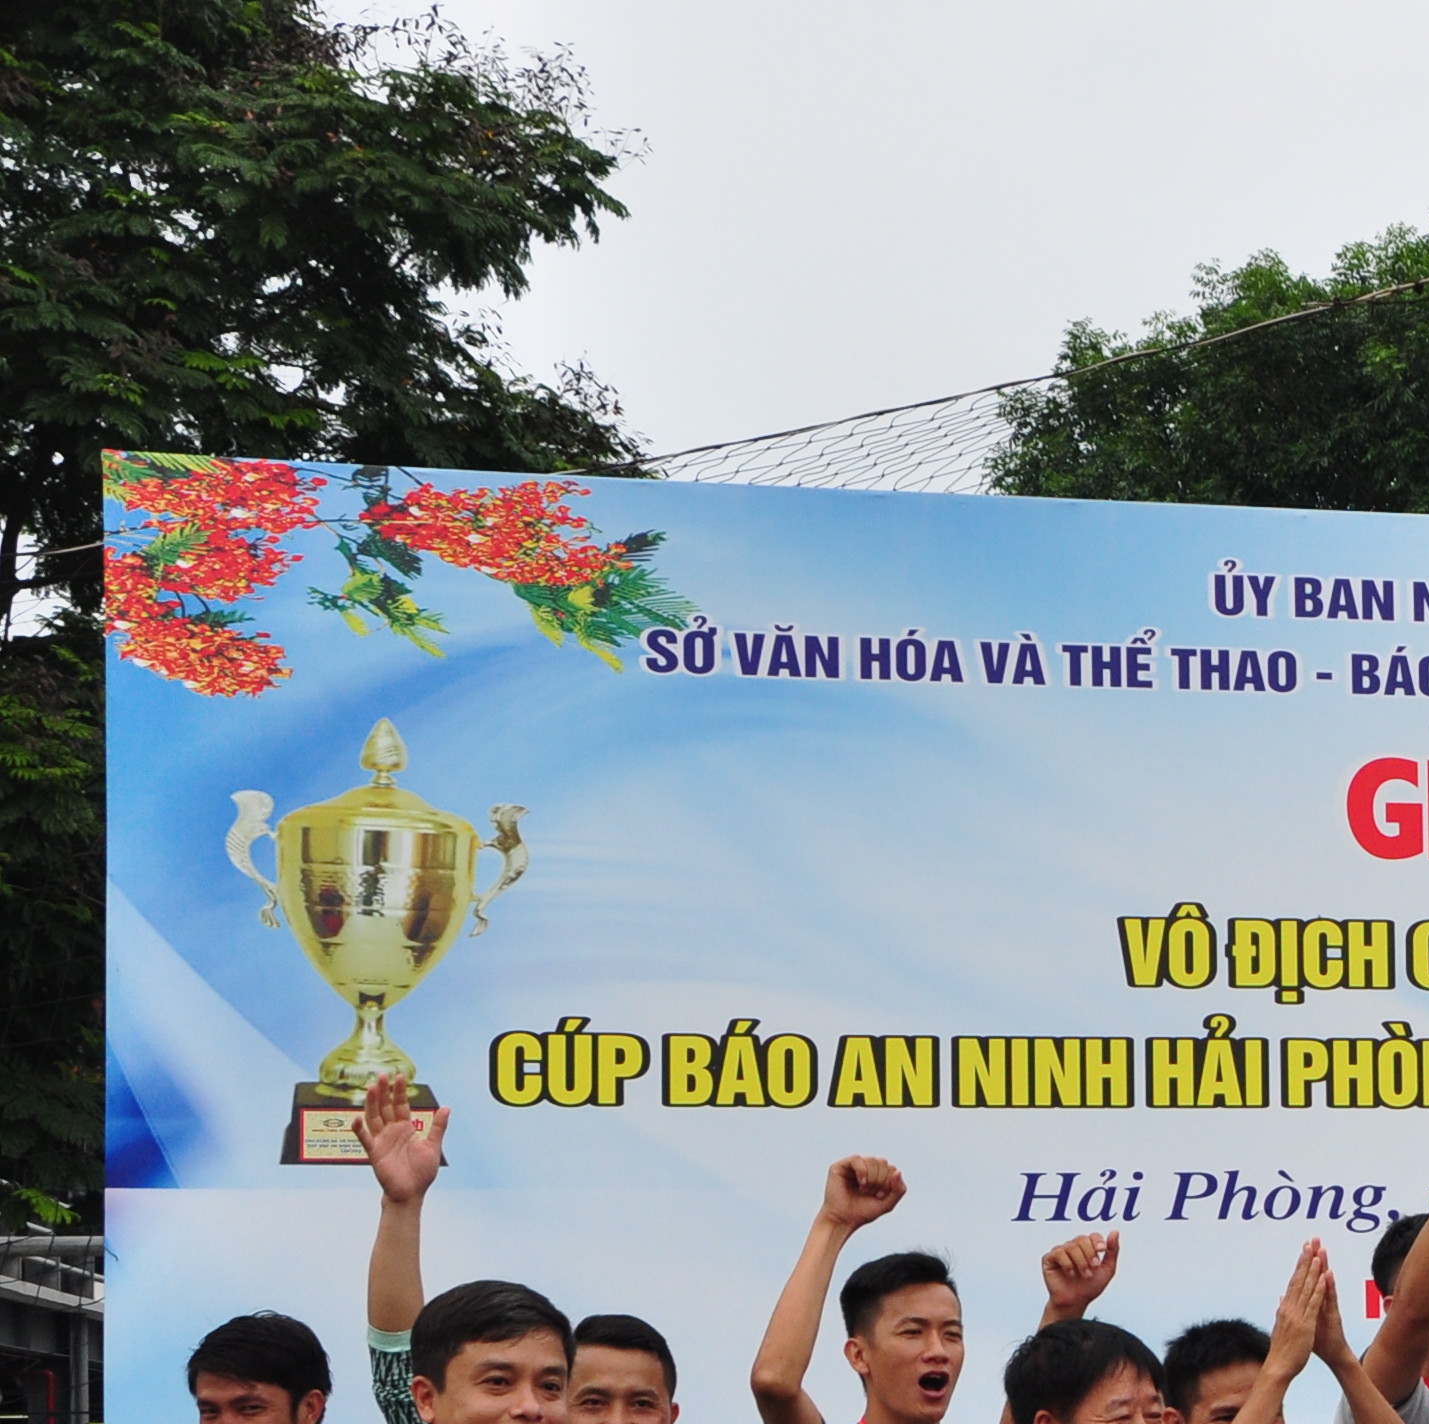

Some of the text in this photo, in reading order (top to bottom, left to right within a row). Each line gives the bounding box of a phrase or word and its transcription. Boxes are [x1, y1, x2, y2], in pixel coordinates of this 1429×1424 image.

[1212, 558, 1276, 617] ỦY
[1293, 576, 1395, 622] BAN
[645, 614, 718, 675] SỞ
[733, 624, 840, 679] VĂN
[859, 628, 964, 683] HÓA
[979, 630, 1046, 686] VÀ
[1061, 627, 1161, 689] THỂ
[1170, 647, 1298, 694] THAO
[1315, 671, 1333, 681] -
[1119, 901, 1215, 990] VÔ
[1227, 916, 1394, 1006] ĐỊCH
[492, 1015, 648, 1108] CÚP
[664, 1017, 816, 1109] BÁO
[829, 1034, 938, 1109] AN
[953, 1035, 1133, 1109] NINH
[1147, 1014, 1268, 1109] HẢI
[1010, 1168, 1143, 1222] Hải
[1164, 1169, 1400, 1232] Phòng,
